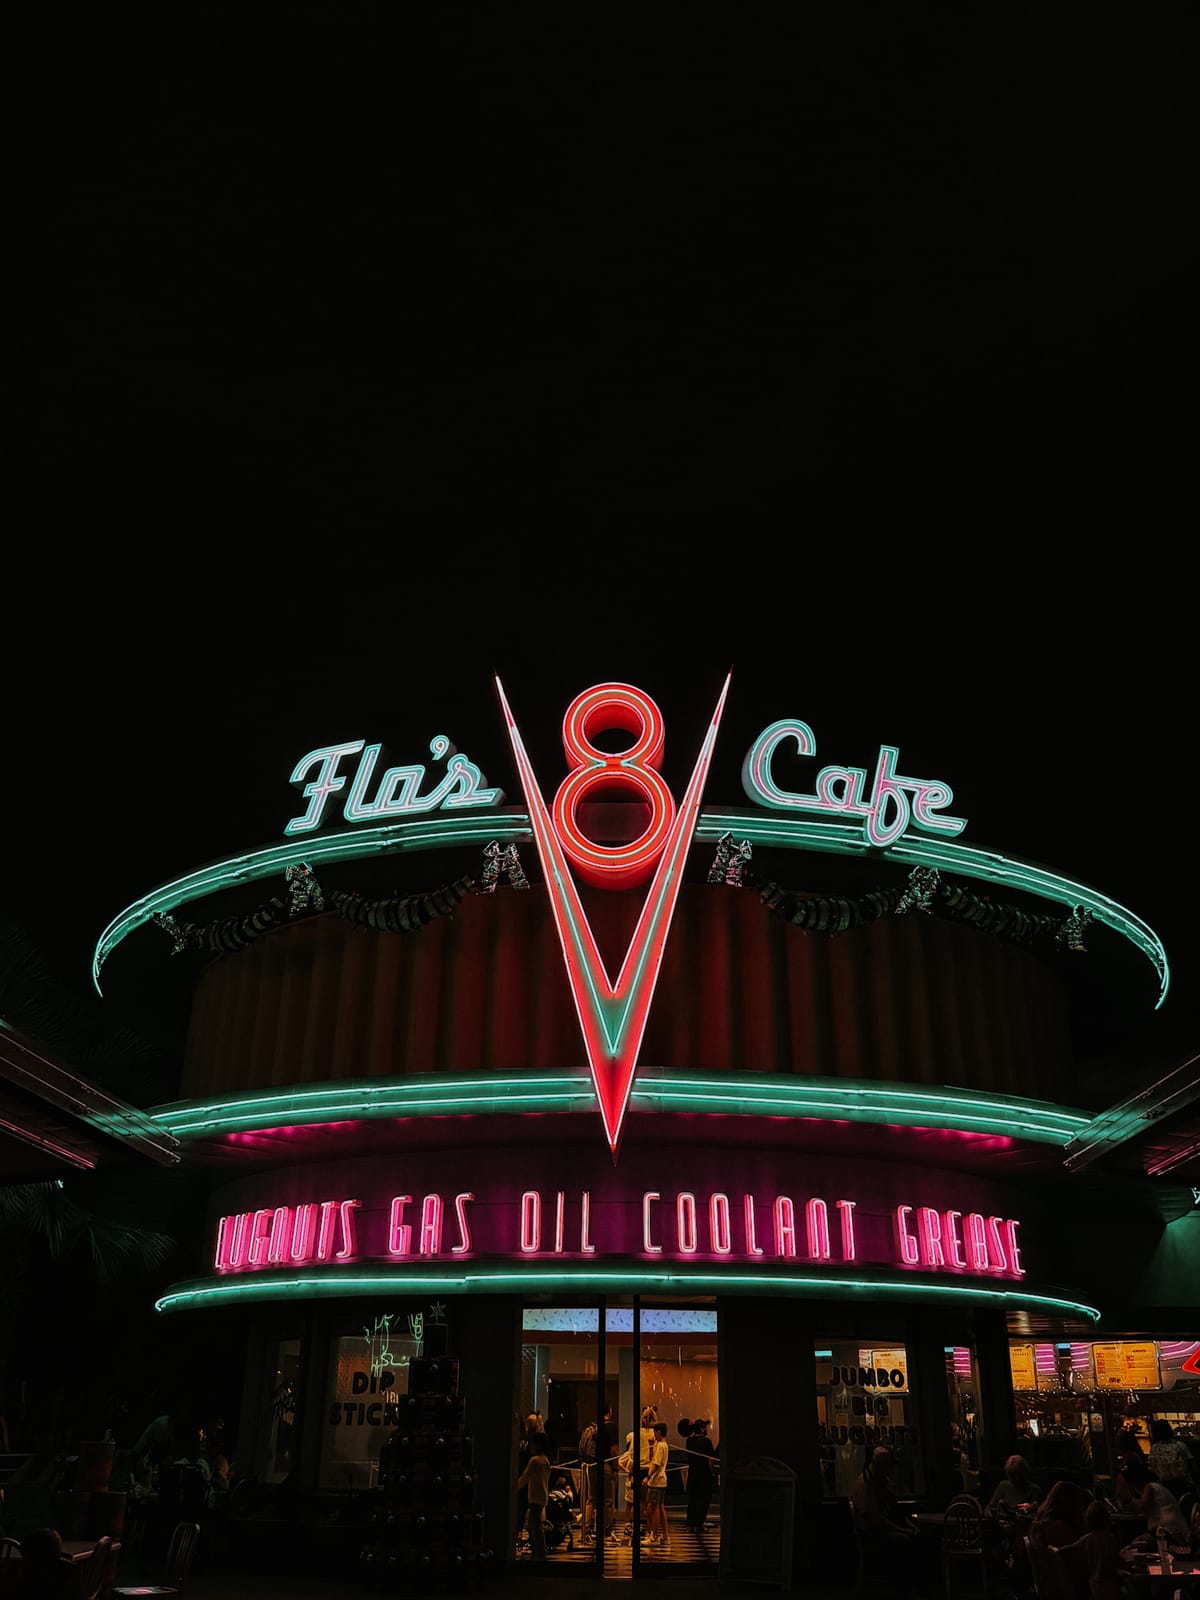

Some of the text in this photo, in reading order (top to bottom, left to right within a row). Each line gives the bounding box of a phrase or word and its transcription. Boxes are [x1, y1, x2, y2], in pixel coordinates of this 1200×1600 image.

[283, 734, 508, 837] Flo's
[741, 718, 968, 847] Cafe
[215, 1191, 1026, 1275] LUGNUTS GAS OIL COOLANT GREASE
[352, 1372, 395, 1395] DIP
[830, 1366, 905, 1388] JUMBO
[852, 1396, 890, 1416] BIG
